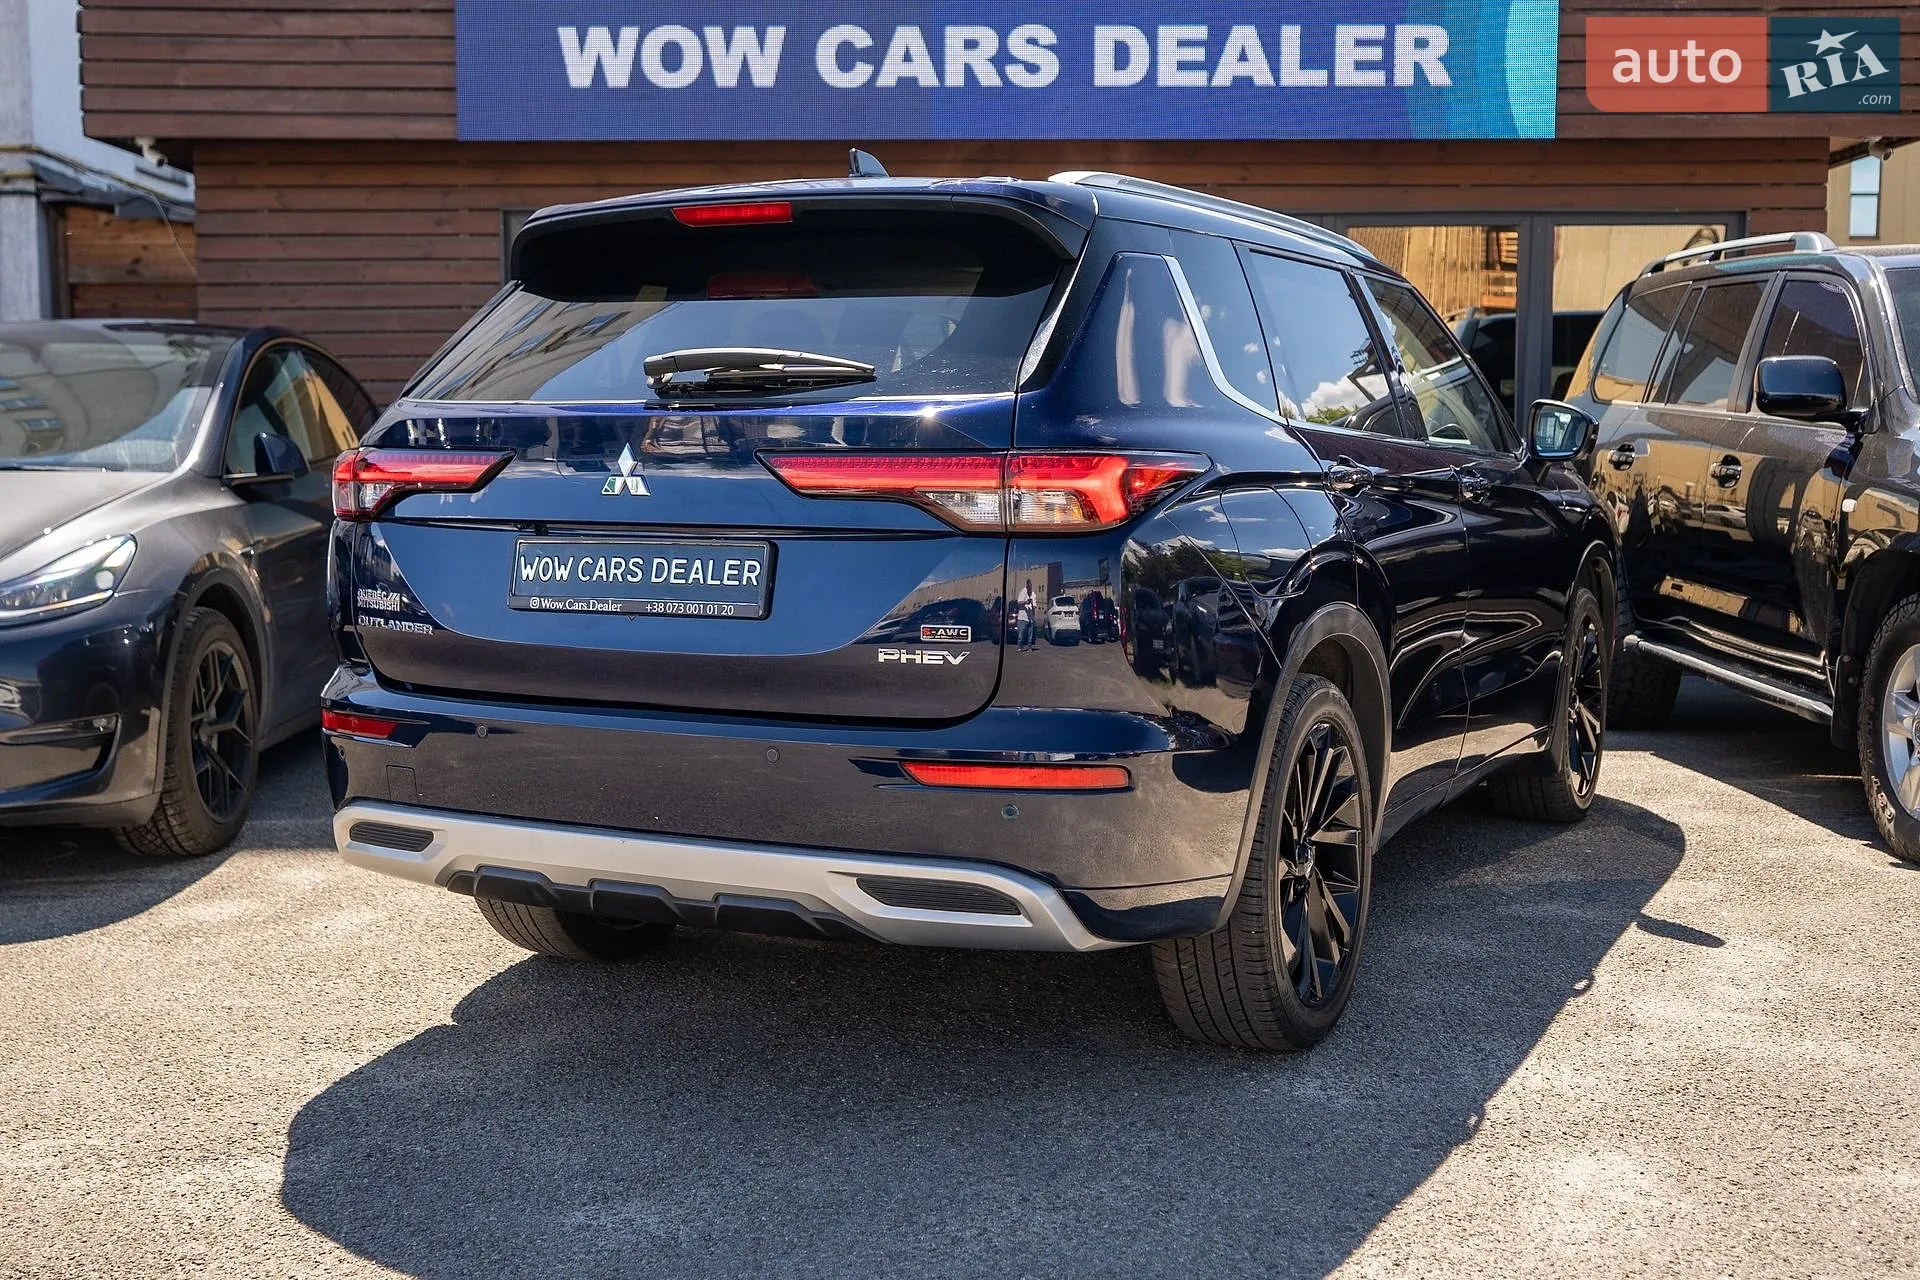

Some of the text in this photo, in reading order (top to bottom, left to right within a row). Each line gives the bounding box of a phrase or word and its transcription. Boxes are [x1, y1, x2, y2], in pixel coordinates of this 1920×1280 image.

[557, 24, 1452, 88] WOW CARS DEALER
[520, 556, 761, 586] WOW CARS DEALER
[645, 602, 734, 616] +38 073 001 01 20
[358, 615, 434, 635] OUTLANDER
[878, 648, 970, 665] PHEV
